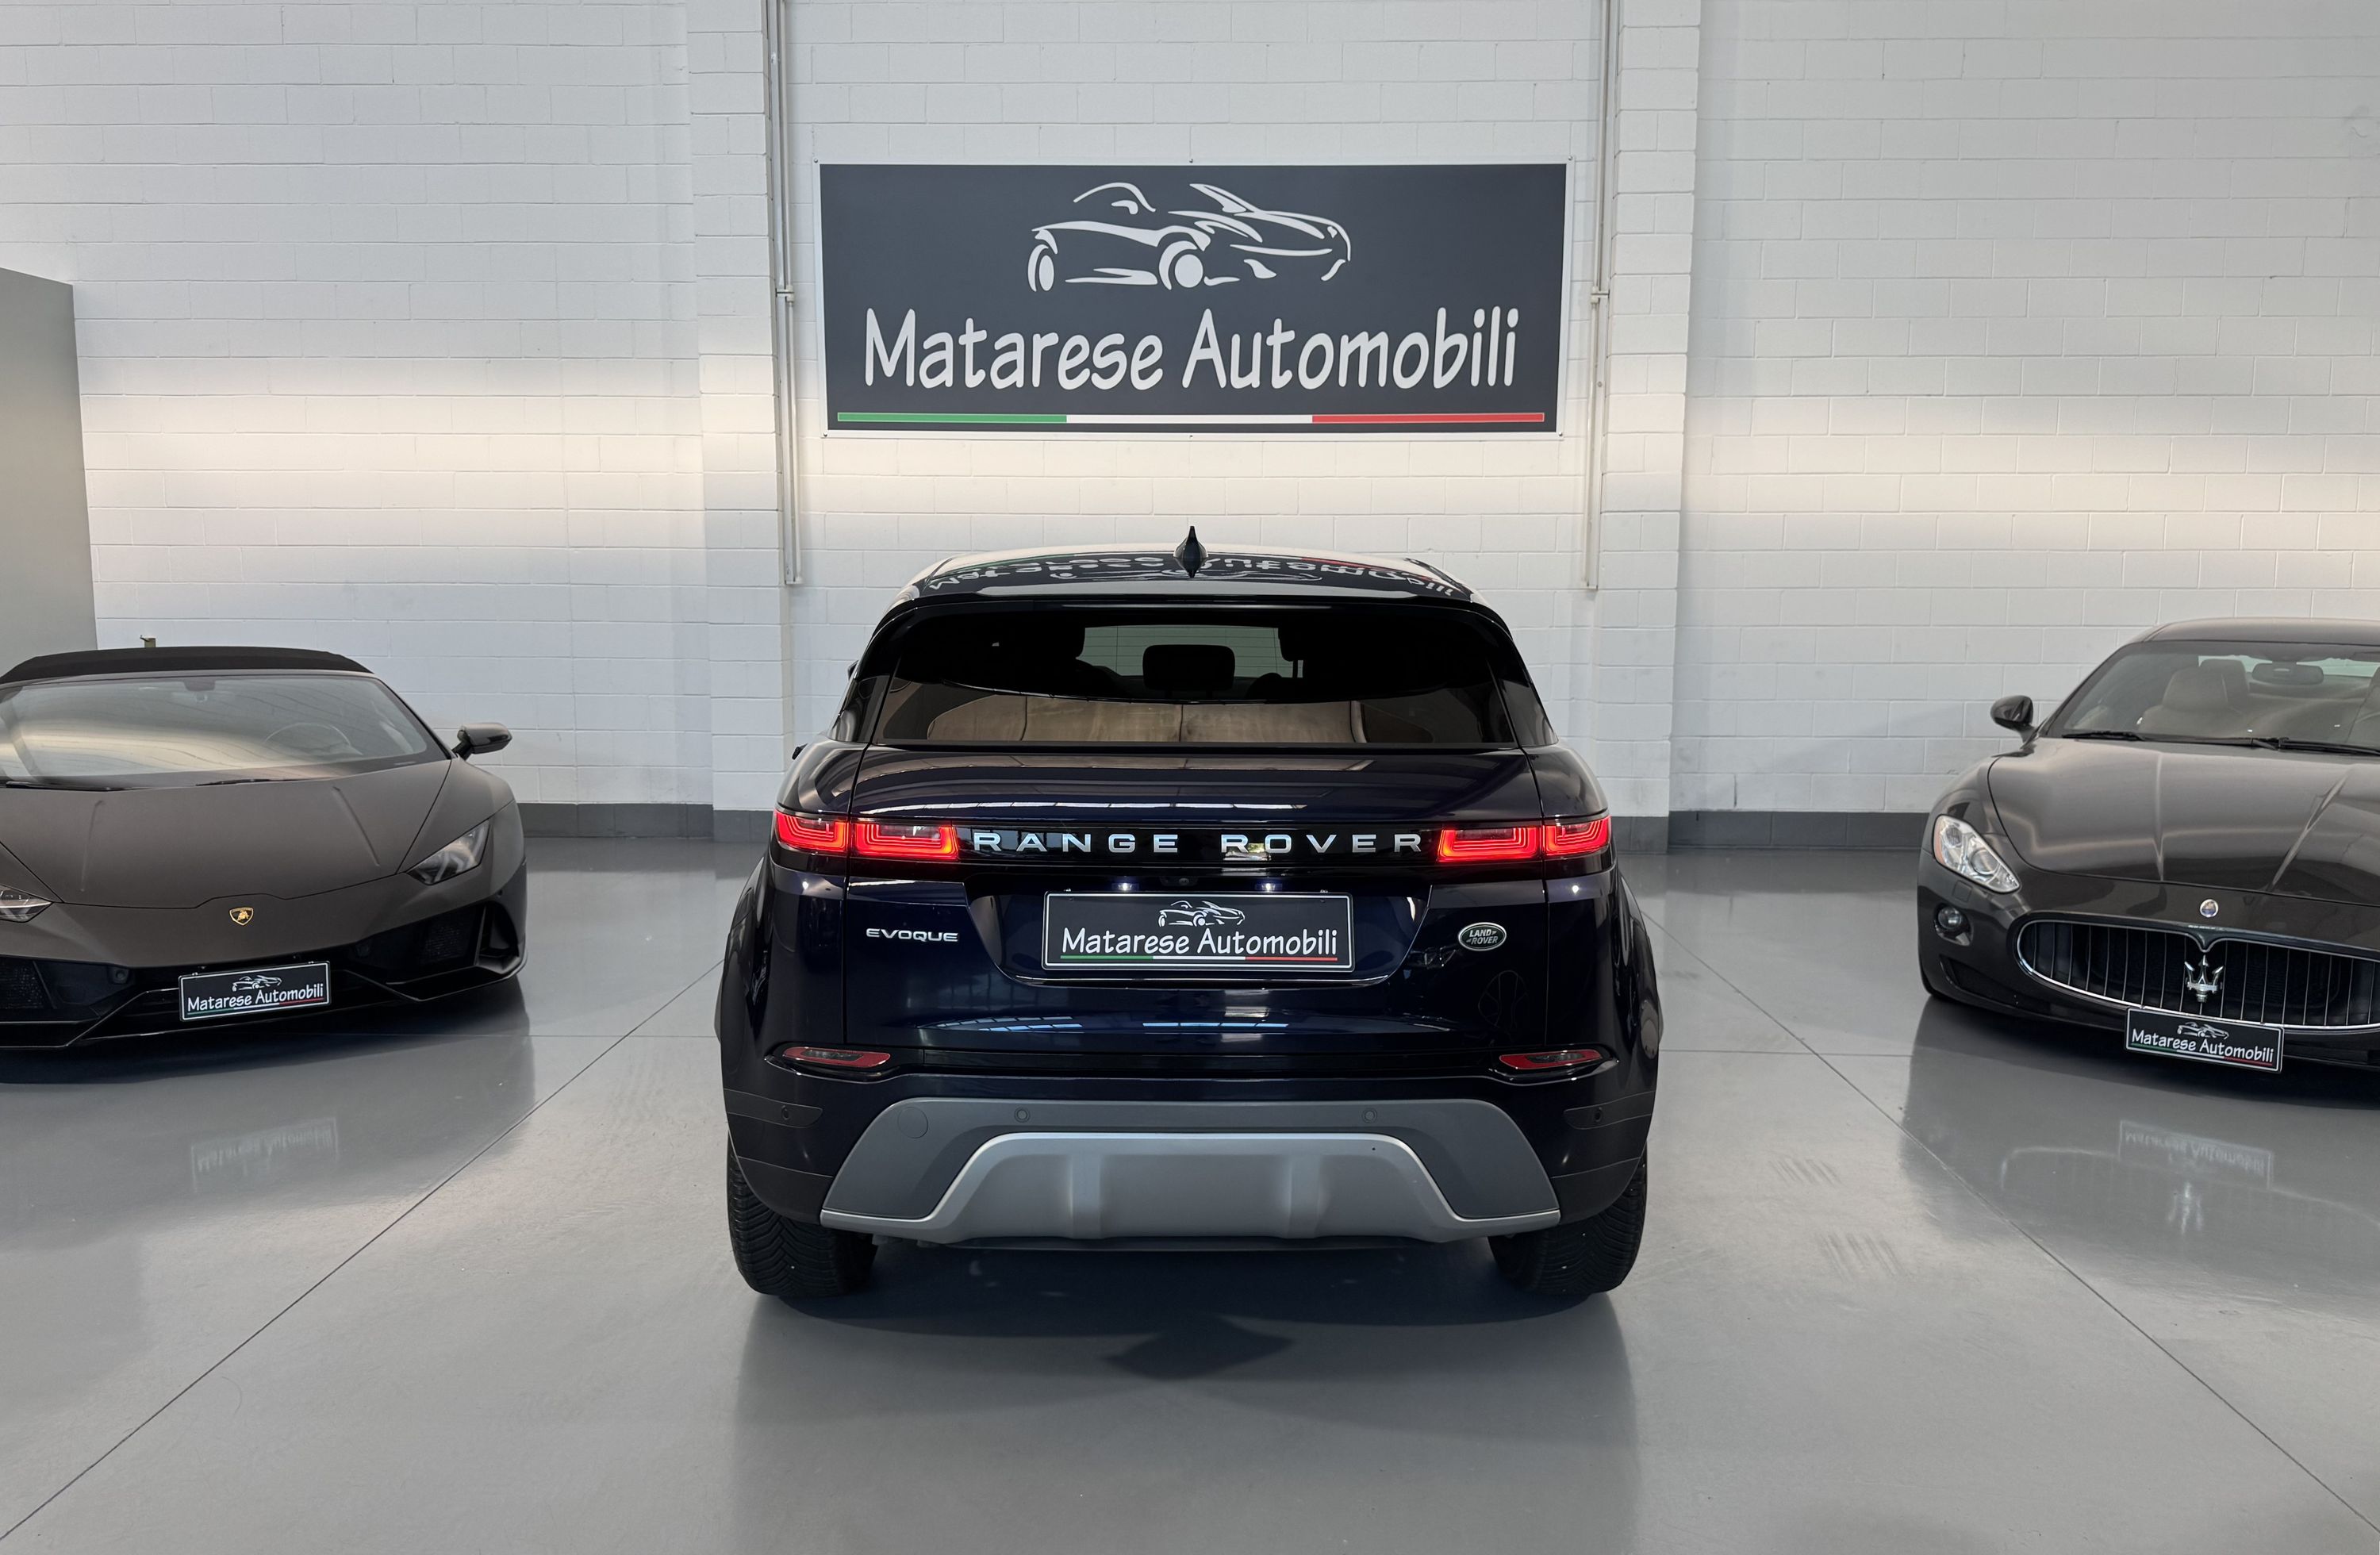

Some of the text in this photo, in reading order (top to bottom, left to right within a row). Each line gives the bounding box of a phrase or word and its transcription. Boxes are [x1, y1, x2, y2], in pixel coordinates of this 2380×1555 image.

[865, 305, 1519, 390] Matarese Automobili
[973, 833, 1422, 854] RANGE ROVER
[866, 928, 958, 942] EVOQUE
[1062, 927, 1338, 955] Matarese Automobili
[188, 983, 324, 1012] Matarese Automobili
[2132, 1028, 2274, 1063] Matarese Automobili
